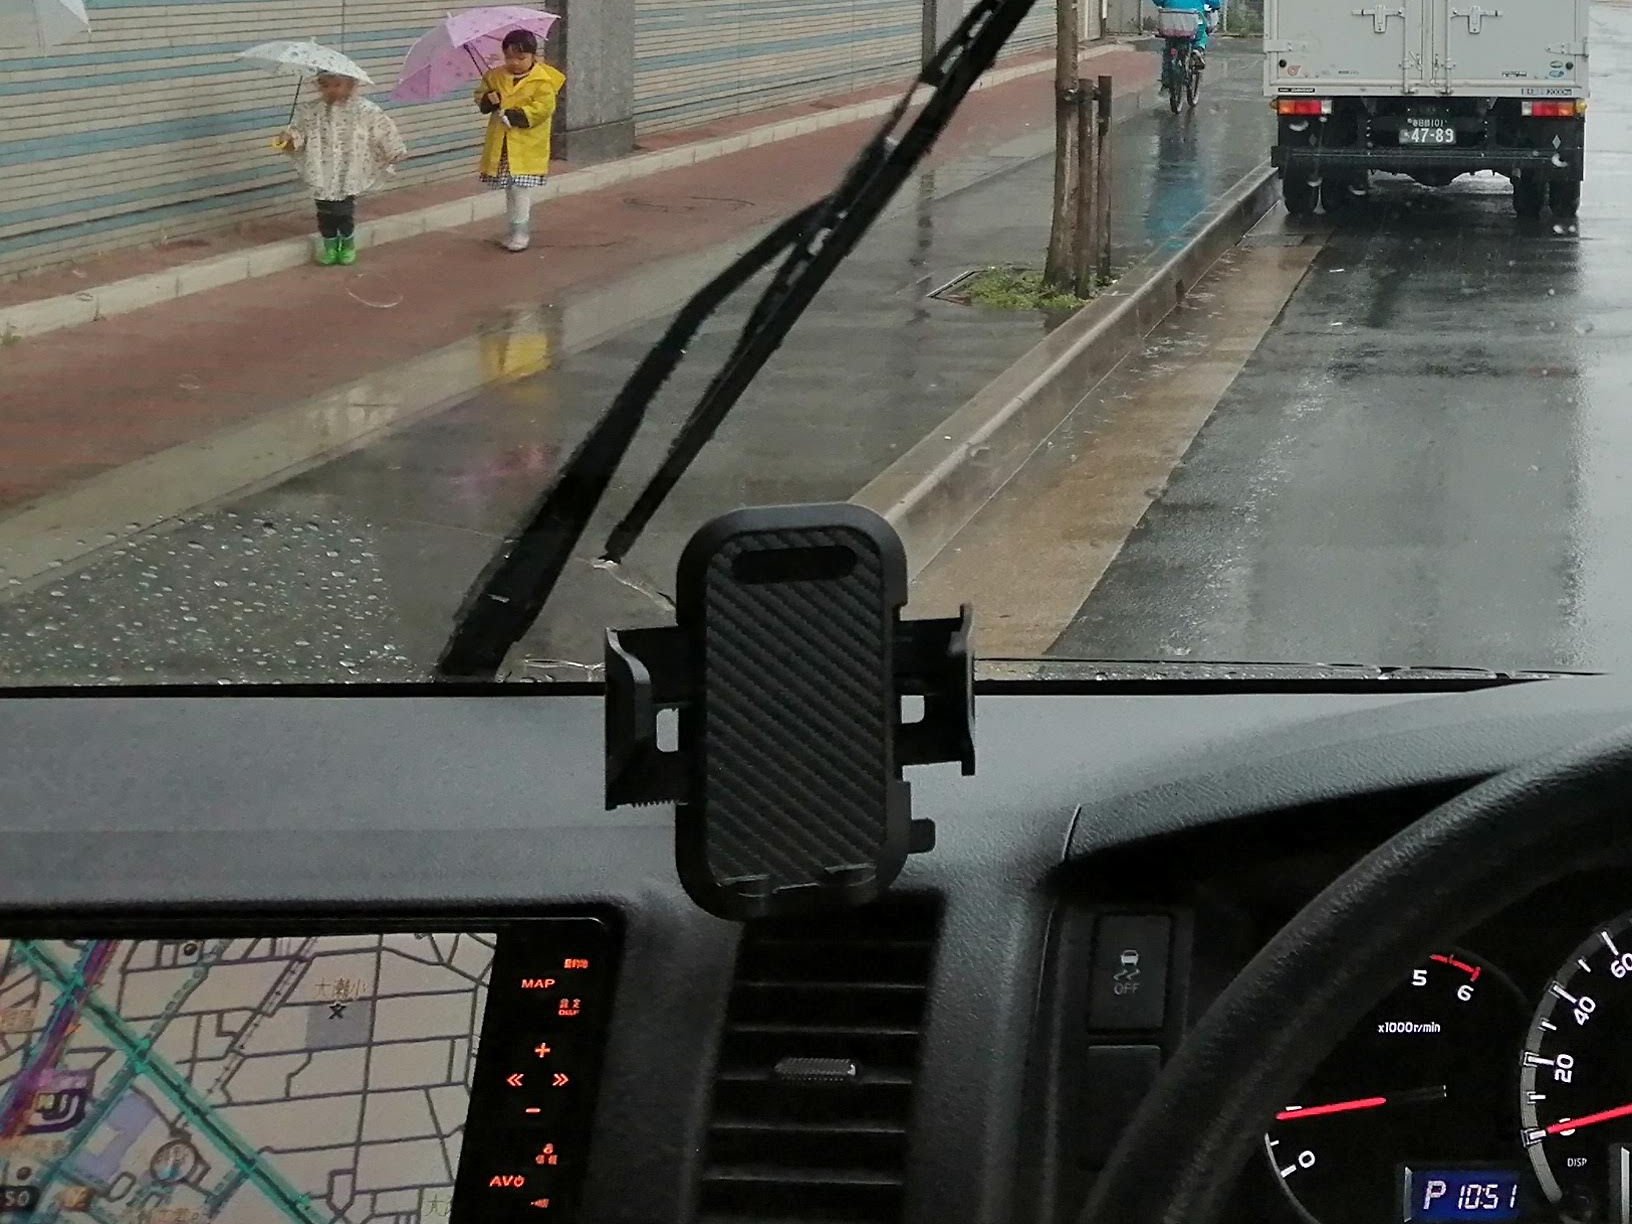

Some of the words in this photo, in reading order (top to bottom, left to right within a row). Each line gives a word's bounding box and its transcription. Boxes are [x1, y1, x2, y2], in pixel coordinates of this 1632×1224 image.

[1411, 128, 1454, 143] 47-89
[521, 979, 555, 989] MAP
[1412, 969, 1428, 986] 5
[1113, 983, 1140, 995] OFF
[1457, 985, 1474, 1001] 6
[1573, 996, 1596, 1025] 40
[1554, 1054, 1575, 1083] 20
[1298, 1150, 1316, 1169] 0
[1567, 1157, 1587, 1168] DISP
[1424, 1181, 1446, 1209] P
[1458, 1184, 1517, 1209] 10:51
